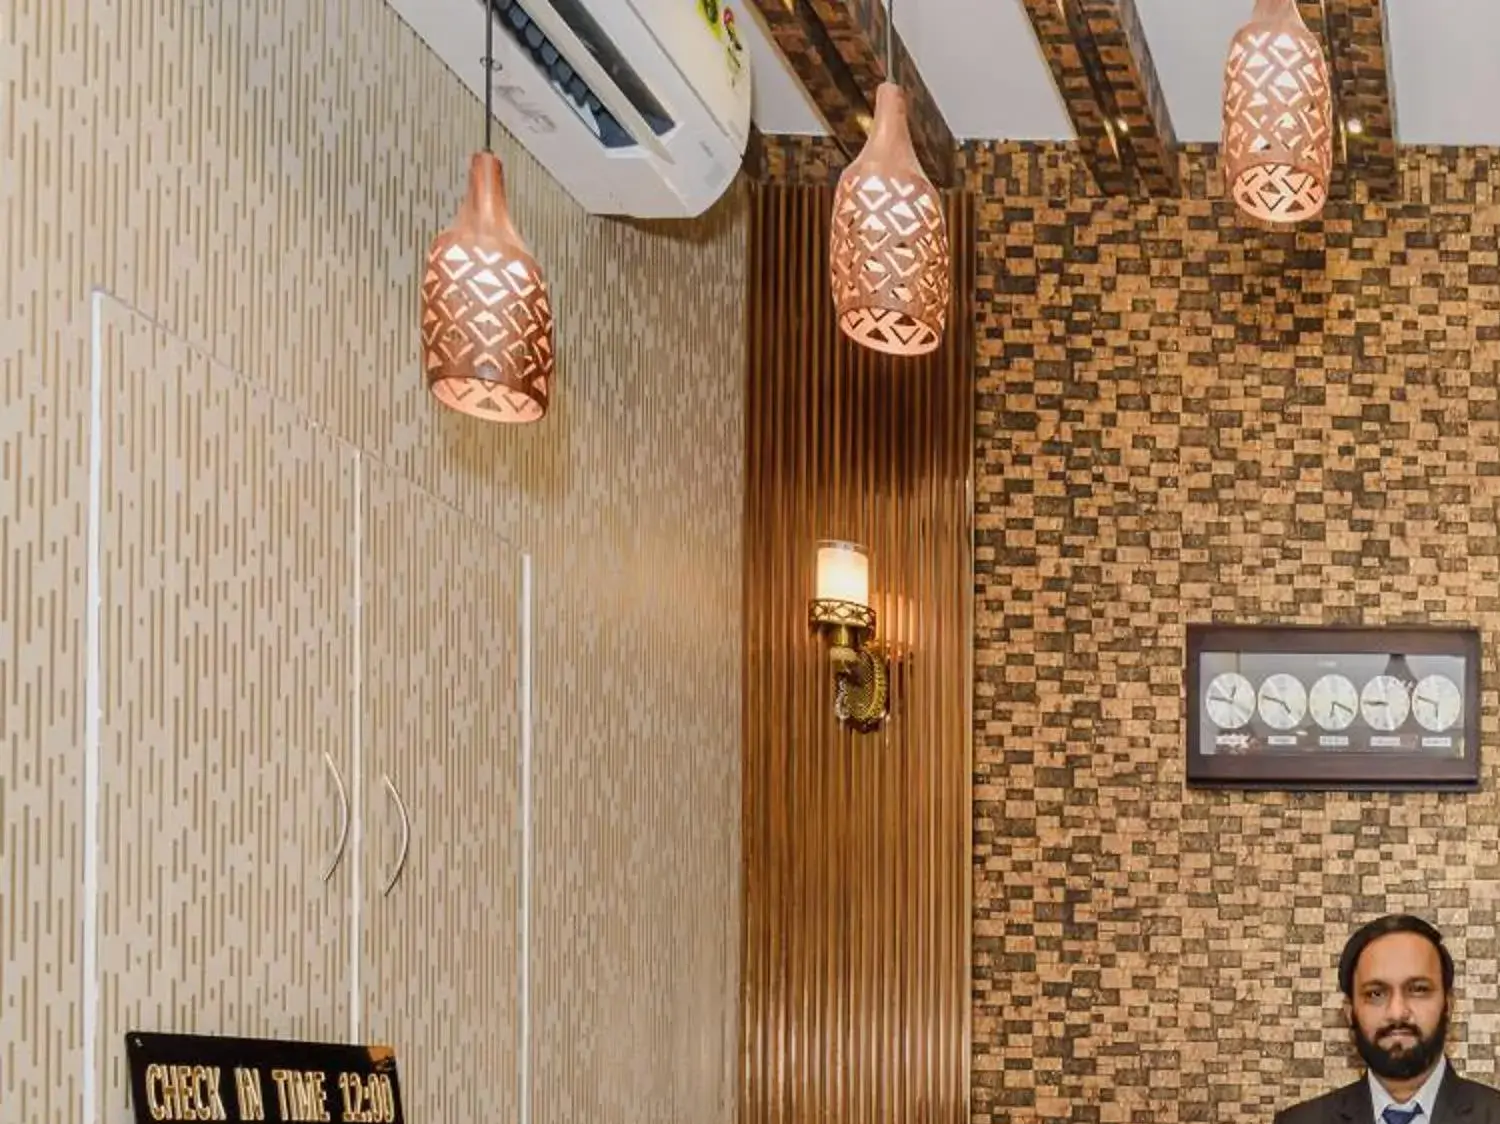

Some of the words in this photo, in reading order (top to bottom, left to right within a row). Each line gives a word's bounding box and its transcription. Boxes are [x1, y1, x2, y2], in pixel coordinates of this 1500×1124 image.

[146, 1063, 226, 1121] CHECK
[234, 1067, 264, 1121] IN
[272, 1069, 330, 1122] TIME
[339, 1072, 395, 1123] 12:00
